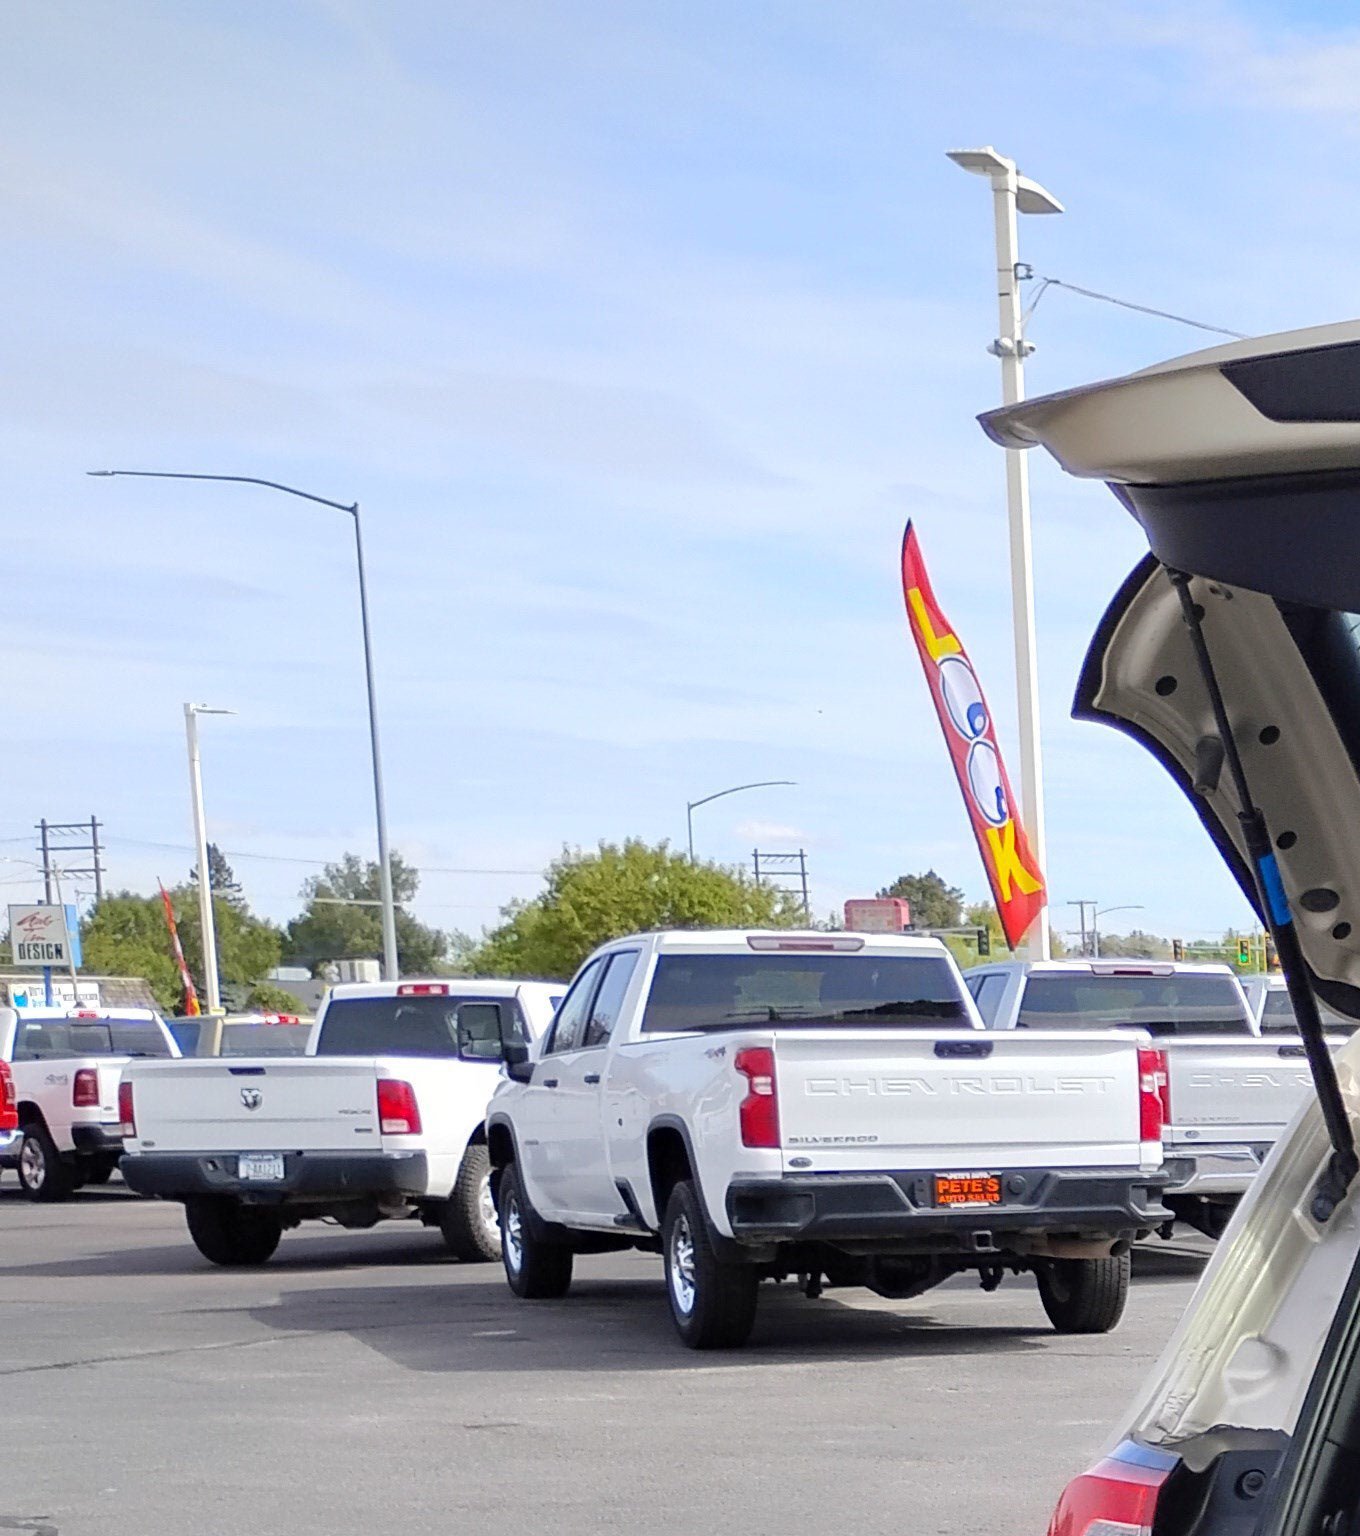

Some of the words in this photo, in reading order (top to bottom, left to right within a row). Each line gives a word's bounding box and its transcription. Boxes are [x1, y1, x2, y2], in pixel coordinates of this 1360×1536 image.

[18, 942, 64, 960] DESIGN
[804, 1077, 1116, 1097] CHEVROLET
[938, 1178, 999, 1194] PETE'S
